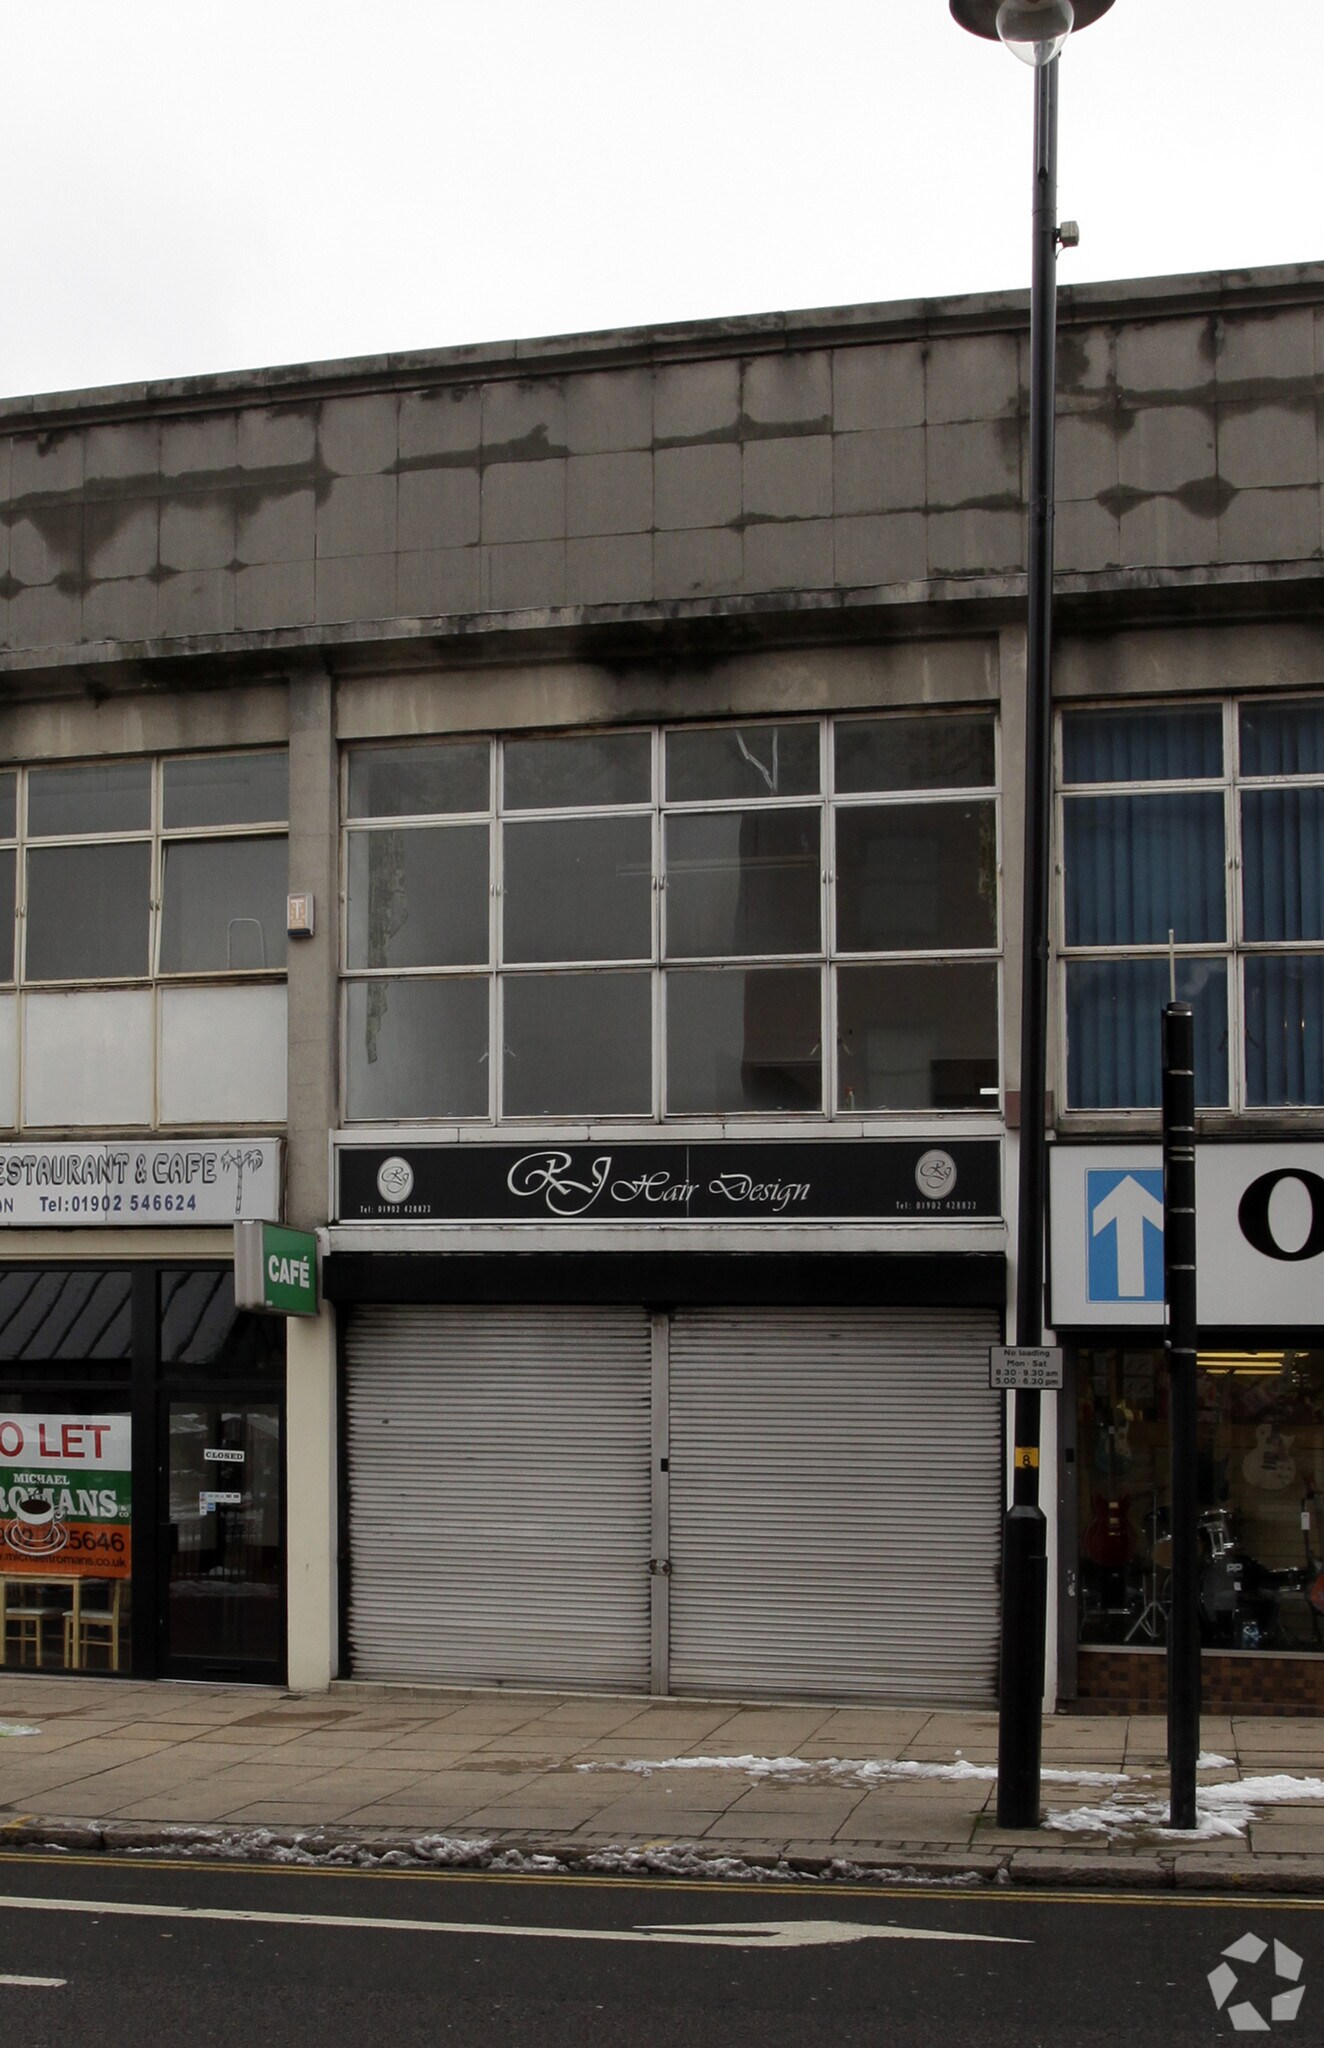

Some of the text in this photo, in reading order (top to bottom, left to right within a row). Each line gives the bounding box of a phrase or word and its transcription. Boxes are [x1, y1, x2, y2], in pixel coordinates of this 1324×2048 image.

[134, 1153, 148, 1185] &
[152, 1152, 218, 1184] CAFE
[0, 1197, 14, 1213] N
[130, 1194, 197, 1211] 546624
[610, 1171, 700, 1202] Hair
[708, 1172, 812, 1212] Design
[1237, 1168, 1324, 1261] O
[268, 1254, 310, 1289] CAFÉ
[1004, 1349, 1050, 1358] No loading
[0, 1421, 111, 1459] O LET
[205, 1451, 243, 1460] CLOSED
[13, 1472, 70, 1486] MICHAEL
[0, 1551, 127, 1568] .michaeltromans.co.uk
